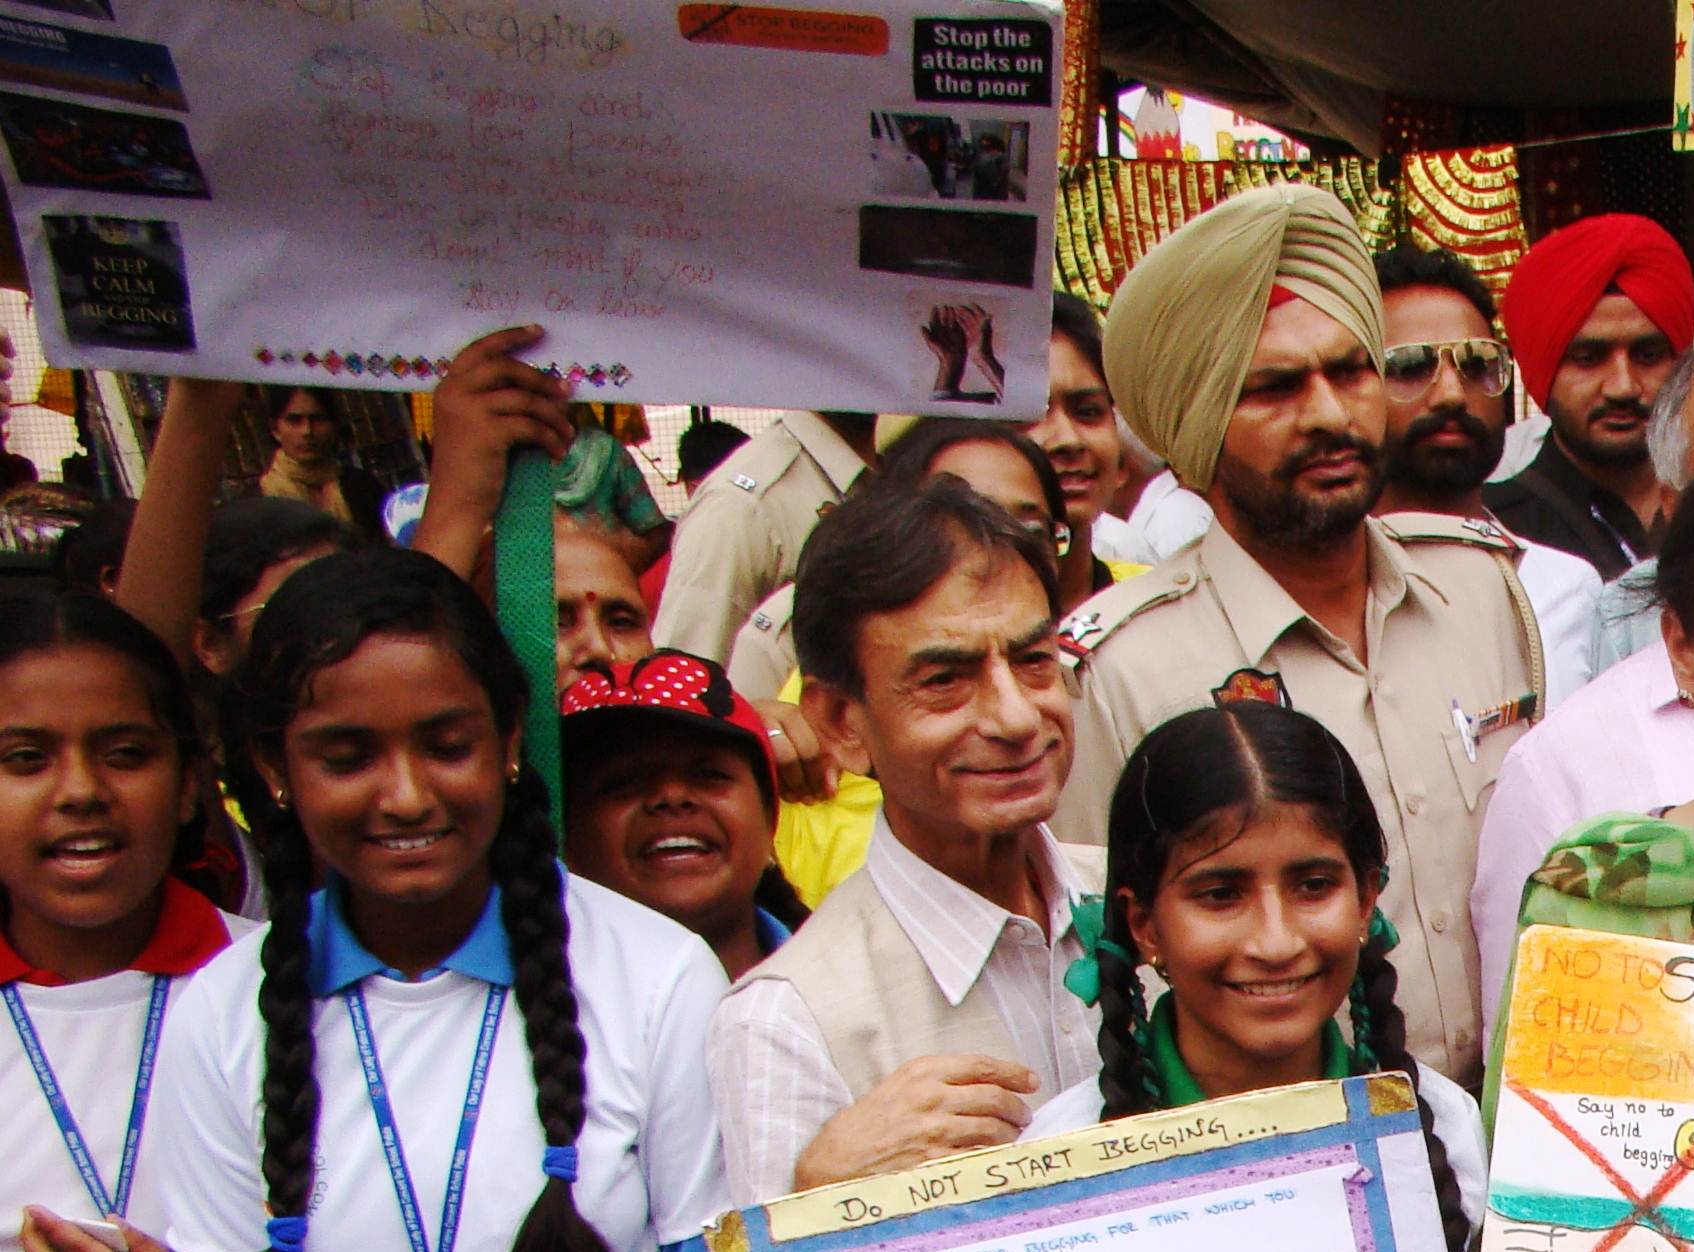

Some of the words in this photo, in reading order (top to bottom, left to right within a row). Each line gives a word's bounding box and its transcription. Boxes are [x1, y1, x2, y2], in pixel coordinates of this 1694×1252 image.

[932, 25, 989, 50] Stop
[993, 28, 1031, 48] the
[921, 51, 1010, 73] attacks
[1015, 57, 1044, 74] on
[935, 75, 974, 96] the
[978, 78, 1031, 98] poor
[92, 256, 149, 275] KEEP
[91, 275, 156, 297] CALM
[79, 300, 179, 327] BEGGING
[1540, 948, 1602, 979] NO
[1617, 954, 1668, 989] TO
[1533, 997, 1645, 1037] CHILD
[1576, 1096, 1615, 1121] Say
[1624, 1101, 1647, 1115] no
[1656, 1102, 1676, 1118] to
[1599, 1121, 1643, 1139] child
[833, 1196, 883, 1223] Do
[907, 1170, 963, 1207] NOT
[983, 1147, 1073, 1190] START
[1106, 1220, 1139, 1239] FOR
[1148, 1210, 1191, 1228] THAT
[1204, 1197, 1257, 1216] WHICH
[1264, 1189, 1297, 1205] YOU
